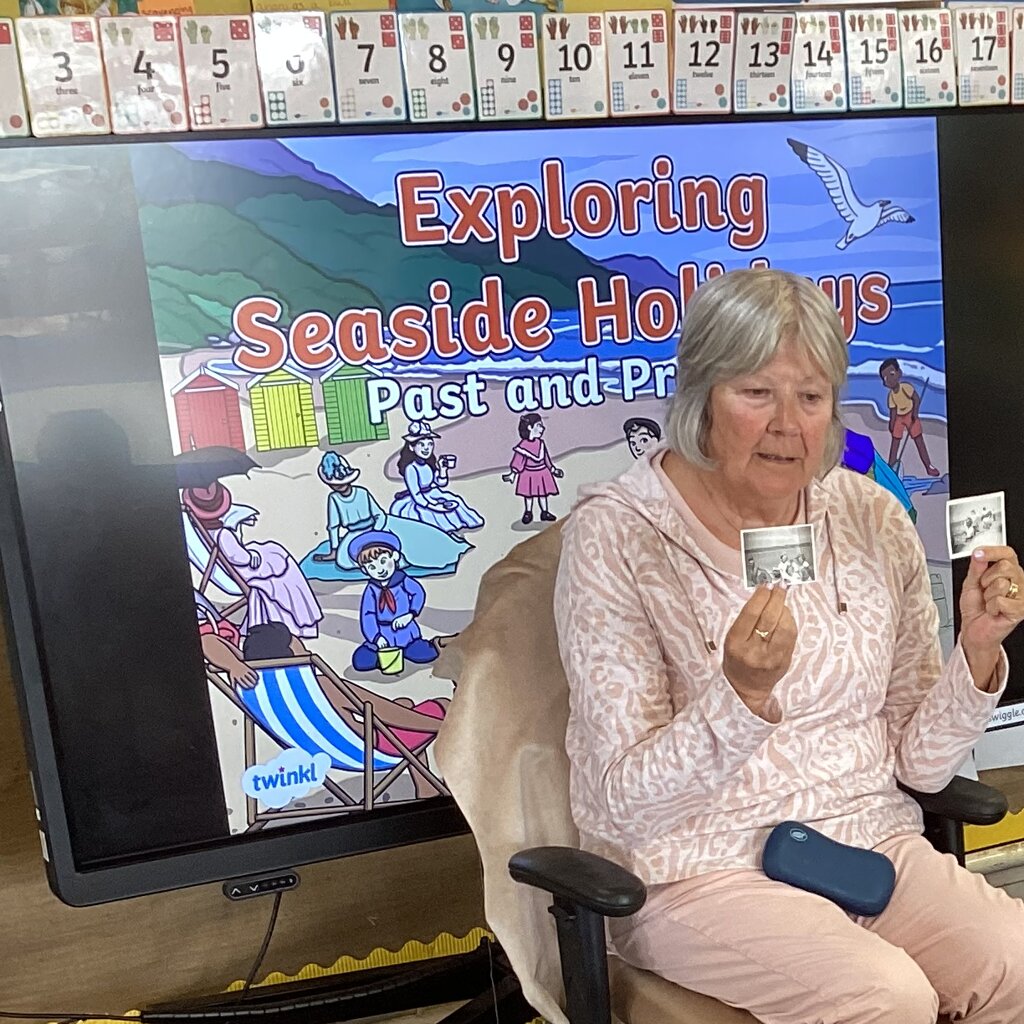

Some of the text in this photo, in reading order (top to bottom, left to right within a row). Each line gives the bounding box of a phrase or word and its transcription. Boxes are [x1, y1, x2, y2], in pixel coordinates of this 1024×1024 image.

[357, 44, 375, 72] 7
[429, 44, 447, 73] 8
[498, 43, 515, 72] 9
[558, 42, 592, 71] 10
[623, 41, 654, 68] 11
[688, 40, 720, 67] 12
[748, 41, 780, 67] 13
[803, 40, 833, 67] 14
[860, 38, 889, 64] 15
[915, 37, 943, 63] 16
[971, 35, 997, 61] 17
[53, 51, 73, 82] 3
[133, 50, 155, 80] 4
[212, 49, 230, 78] 5
[396, 158, 768, 262] Exploring
[232, 275, 554, 374] Seaside
[365, 373, 490, 426] Past
[506, 357, 604, 412] and
[252, 762, 318, 792] twinkl
